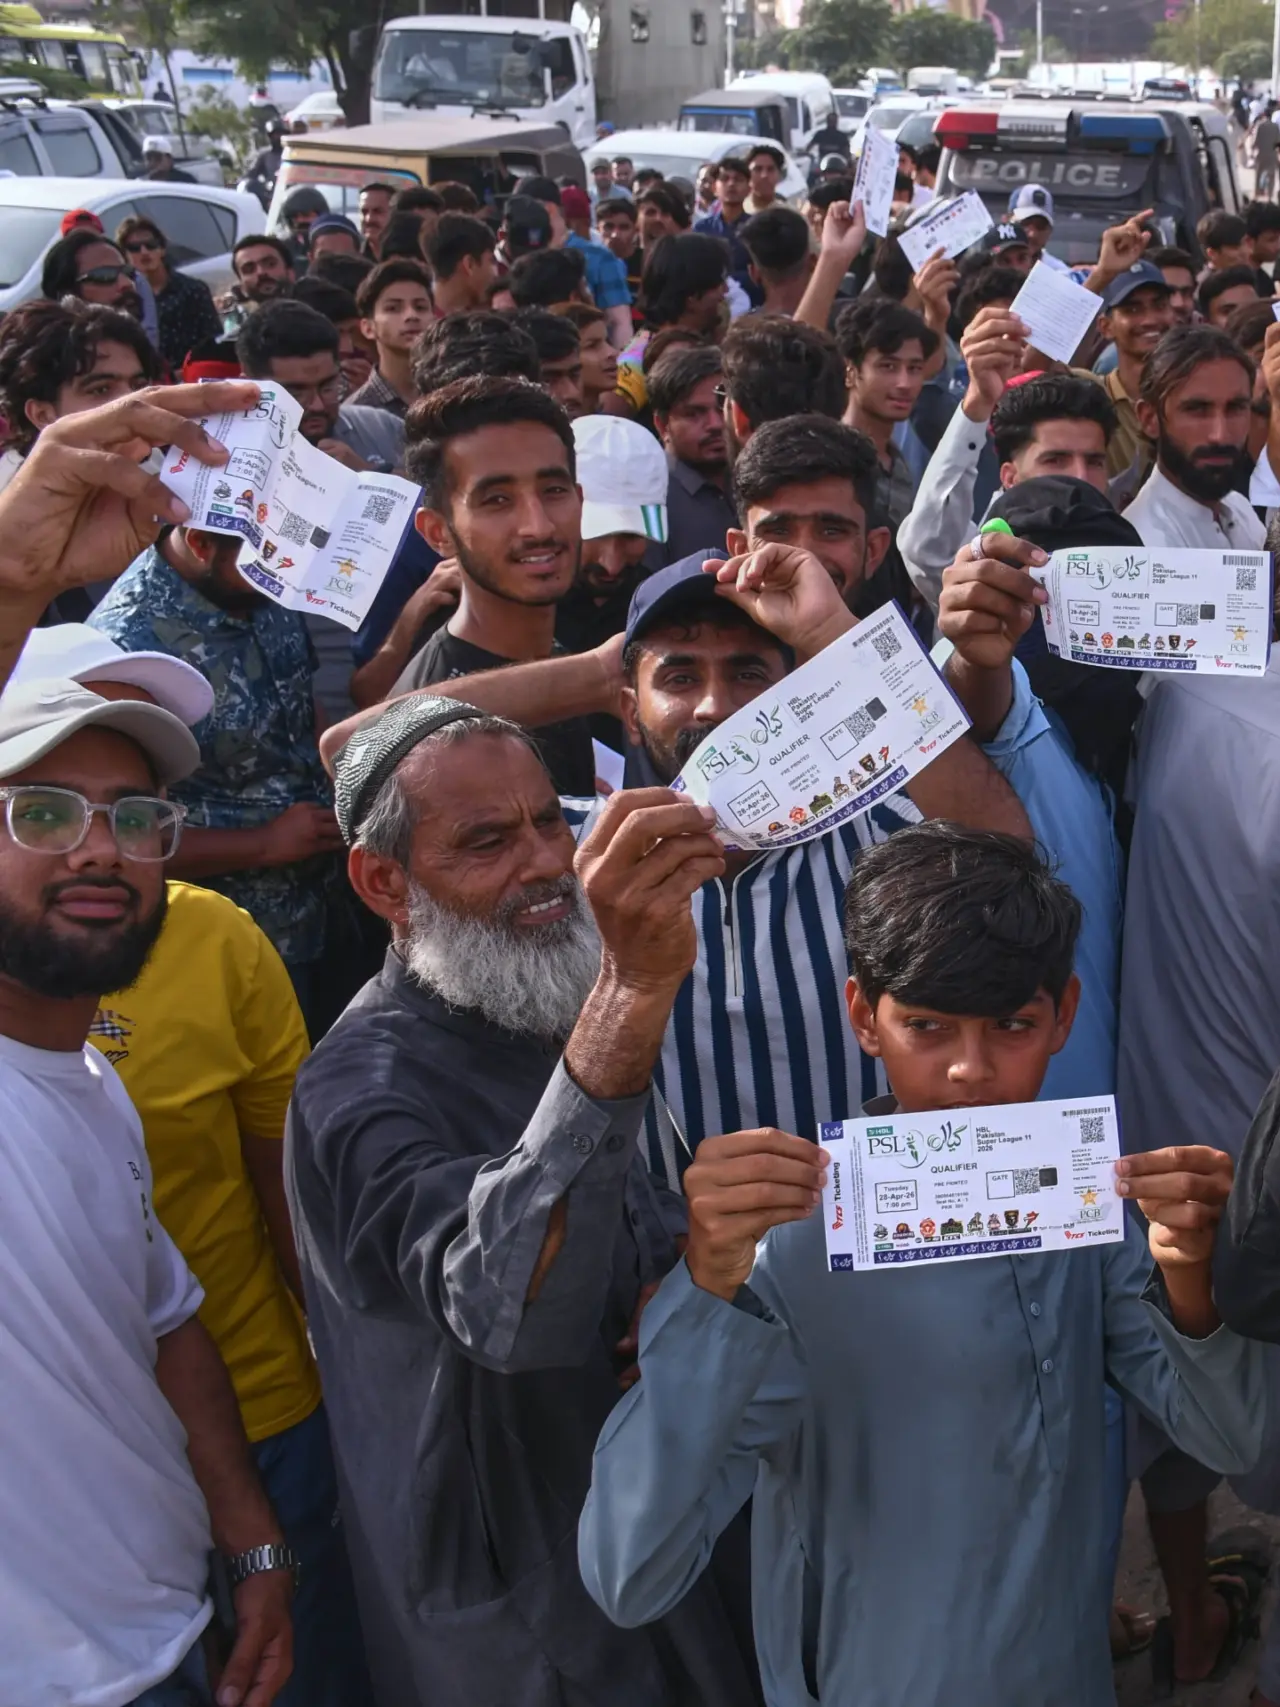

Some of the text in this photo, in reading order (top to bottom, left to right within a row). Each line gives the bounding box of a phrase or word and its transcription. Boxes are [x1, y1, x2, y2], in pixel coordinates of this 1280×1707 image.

[970, 158, 1122, 189] POLICE
[1066, 562, 1095, 575] PSL
[329, 601, 361, 622] Ticketing
[1230, 644, 1248, 652] PCB
[787, 697, 801, 706] HBL
[791, 692, 817, 712] Pakistan
[794, 703, 815, 719] Super
[812, 687, 835, 706] League
[799, 712, 815, 724] 2026
[827, 727, 844, 742] GATE
[938, 720, 963, 747] Ticketing
[769, 734, 811, 766] QUALIFIER
[699, 749, 736, 781] PSL
[736, 789, 760, 807] Tuesday
[736, 792, 771, 818] 28-Apr-26
[868, 1136, 906, 1155] PSL
[998, 1136, 1023, 1144] League
[931, 1162, 977, 1174] QUALIFIER
[879, 1192, 914, 1201] 28-Apr-26
[1080, 1209, 1101, 1218] PCB
[1088, 1229, 1119, 1237] Ticketing
